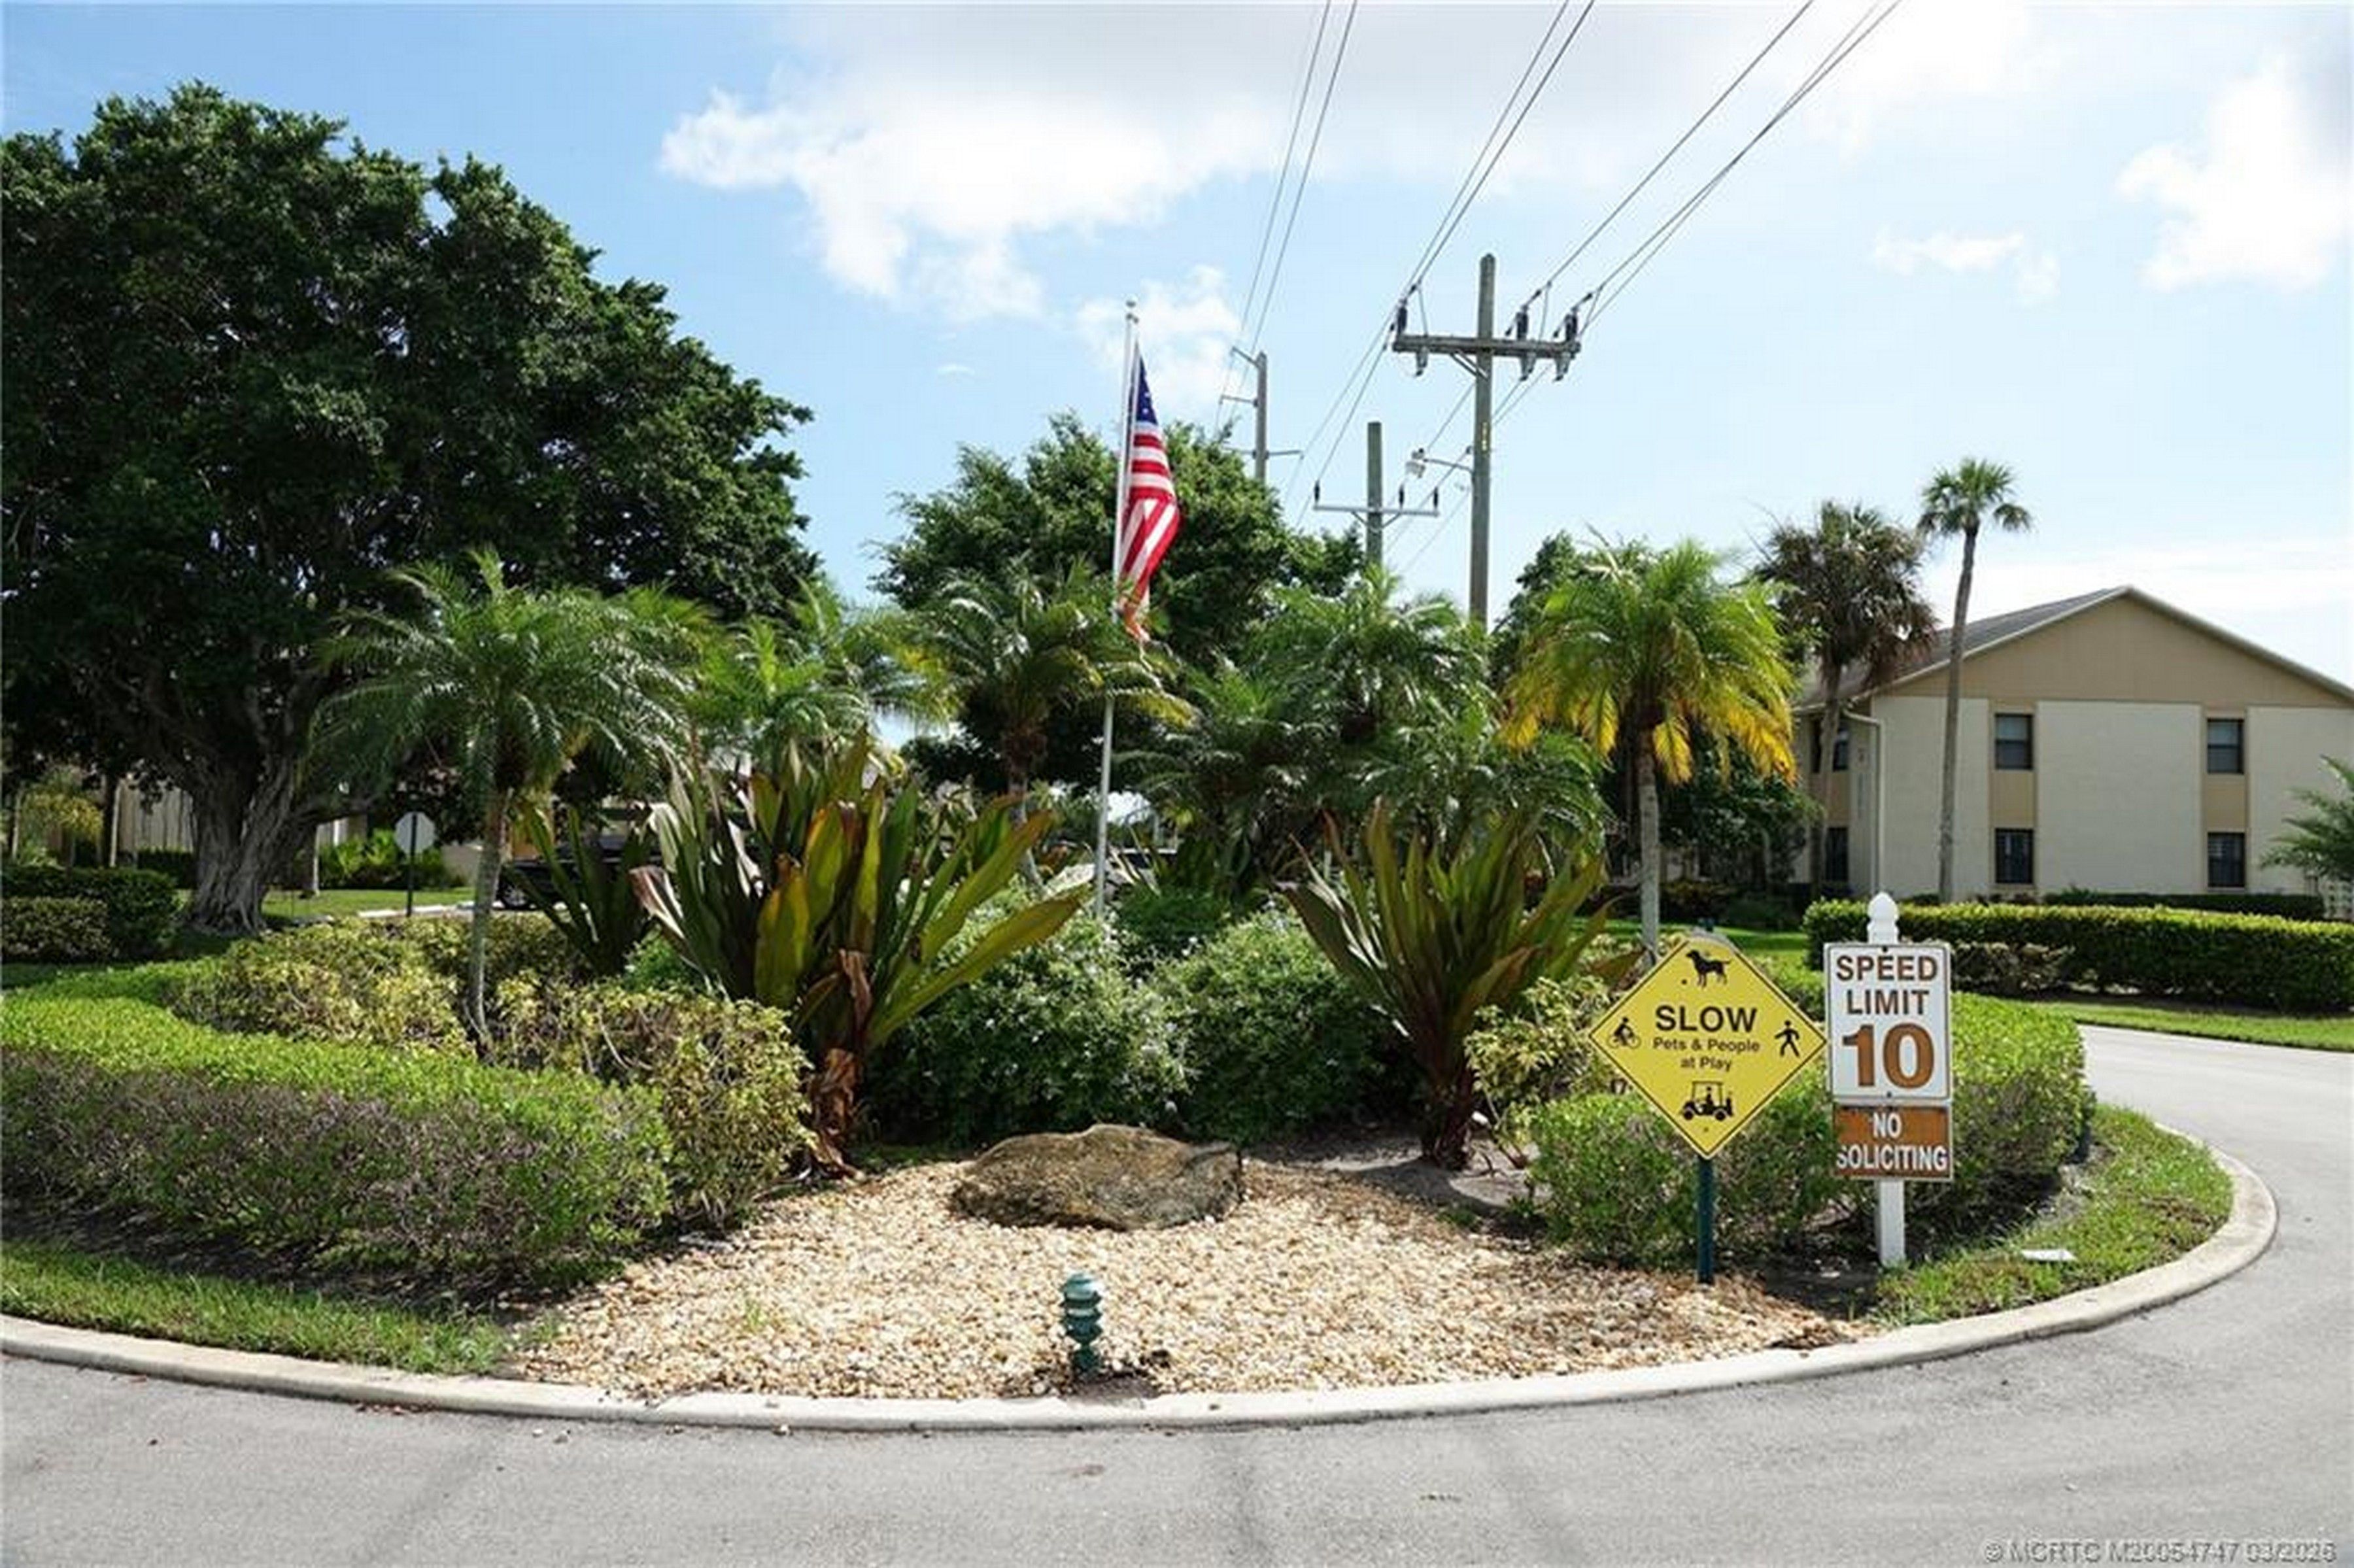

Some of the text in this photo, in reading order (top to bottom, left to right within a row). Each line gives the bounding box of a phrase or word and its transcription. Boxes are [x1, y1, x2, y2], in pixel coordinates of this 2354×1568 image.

[1837, 955, 1938, 981] SPEED
[1847, 990, 1930, 1015] LIMIT
[1655, 1006, 1758, 1033] SLOW
[1652, 1037, 1760, 1054] Pets & People
[1842, 1023, 1935, 1089] 10
[1680, 1056, 1732, 1074] at Play
[1873, 1112, 1902, 1138] NO
[1836, 1145, 1948, 1170] SOLICITING
